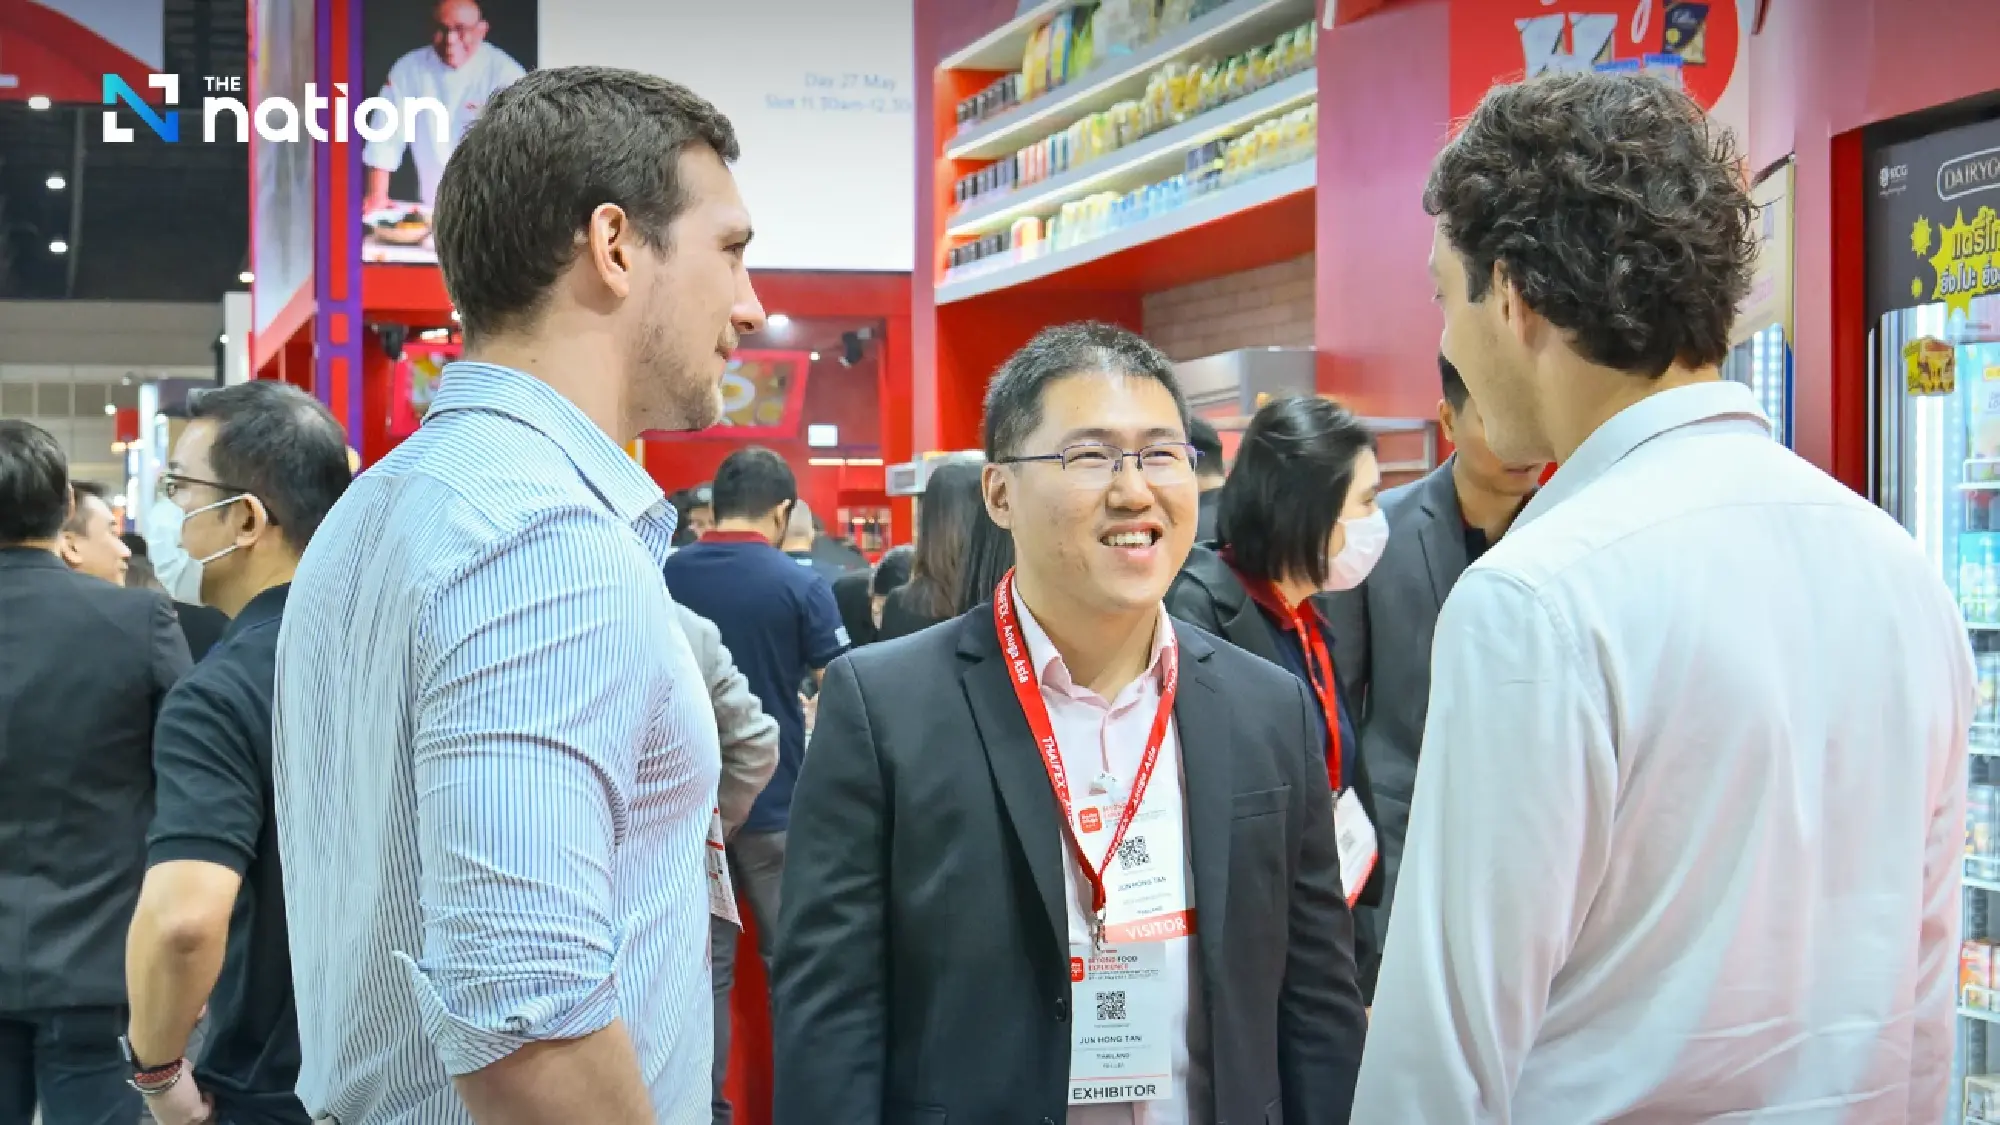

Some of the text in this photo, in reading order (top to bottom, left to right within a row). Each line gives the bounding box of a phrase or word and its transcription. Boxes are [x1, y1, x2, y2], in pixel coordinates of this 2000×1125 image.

[804, 72, 835, 88] Day
[864, 73, 895, 92] May
[1042, 735, 1067, 789] THAIFEX
[1125, 915, 1187, 941] VISITOR
[1079, 1034, 1143, 1045] JUN HONG TAN
[1072, 1083, 1157, 1101] EXHIBITOR
